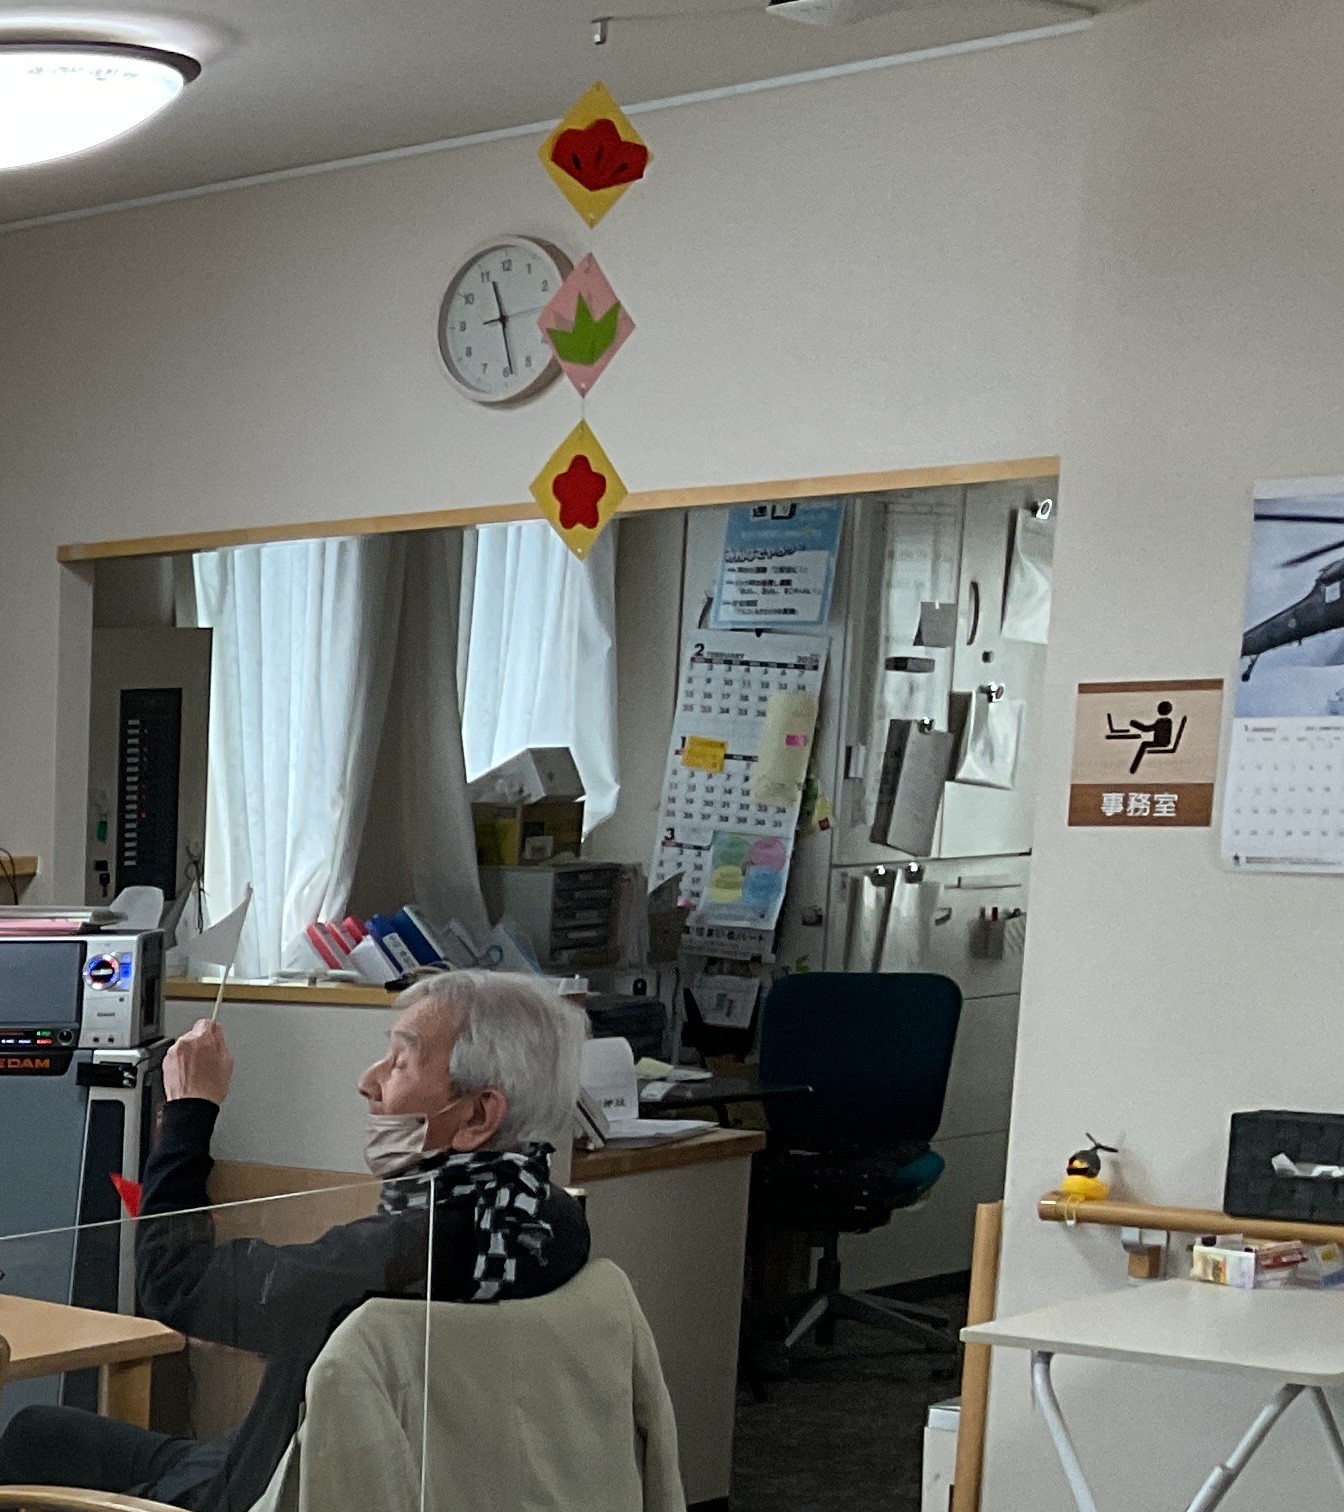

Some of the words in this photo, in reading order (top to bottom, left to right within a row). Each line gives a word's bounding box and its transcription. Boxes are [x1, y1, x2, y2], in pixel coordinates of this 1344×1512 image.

[501, 259, 512, 272] 12
[480, 271, 490, 283] 11
[541, 279, 549, 292] 2
[481, 362, 488, 374] 7
[694, 643, 705, 657] 2
[1100, 791, 1179, 817] 事務室
[664, 828, 675, 840] 3
